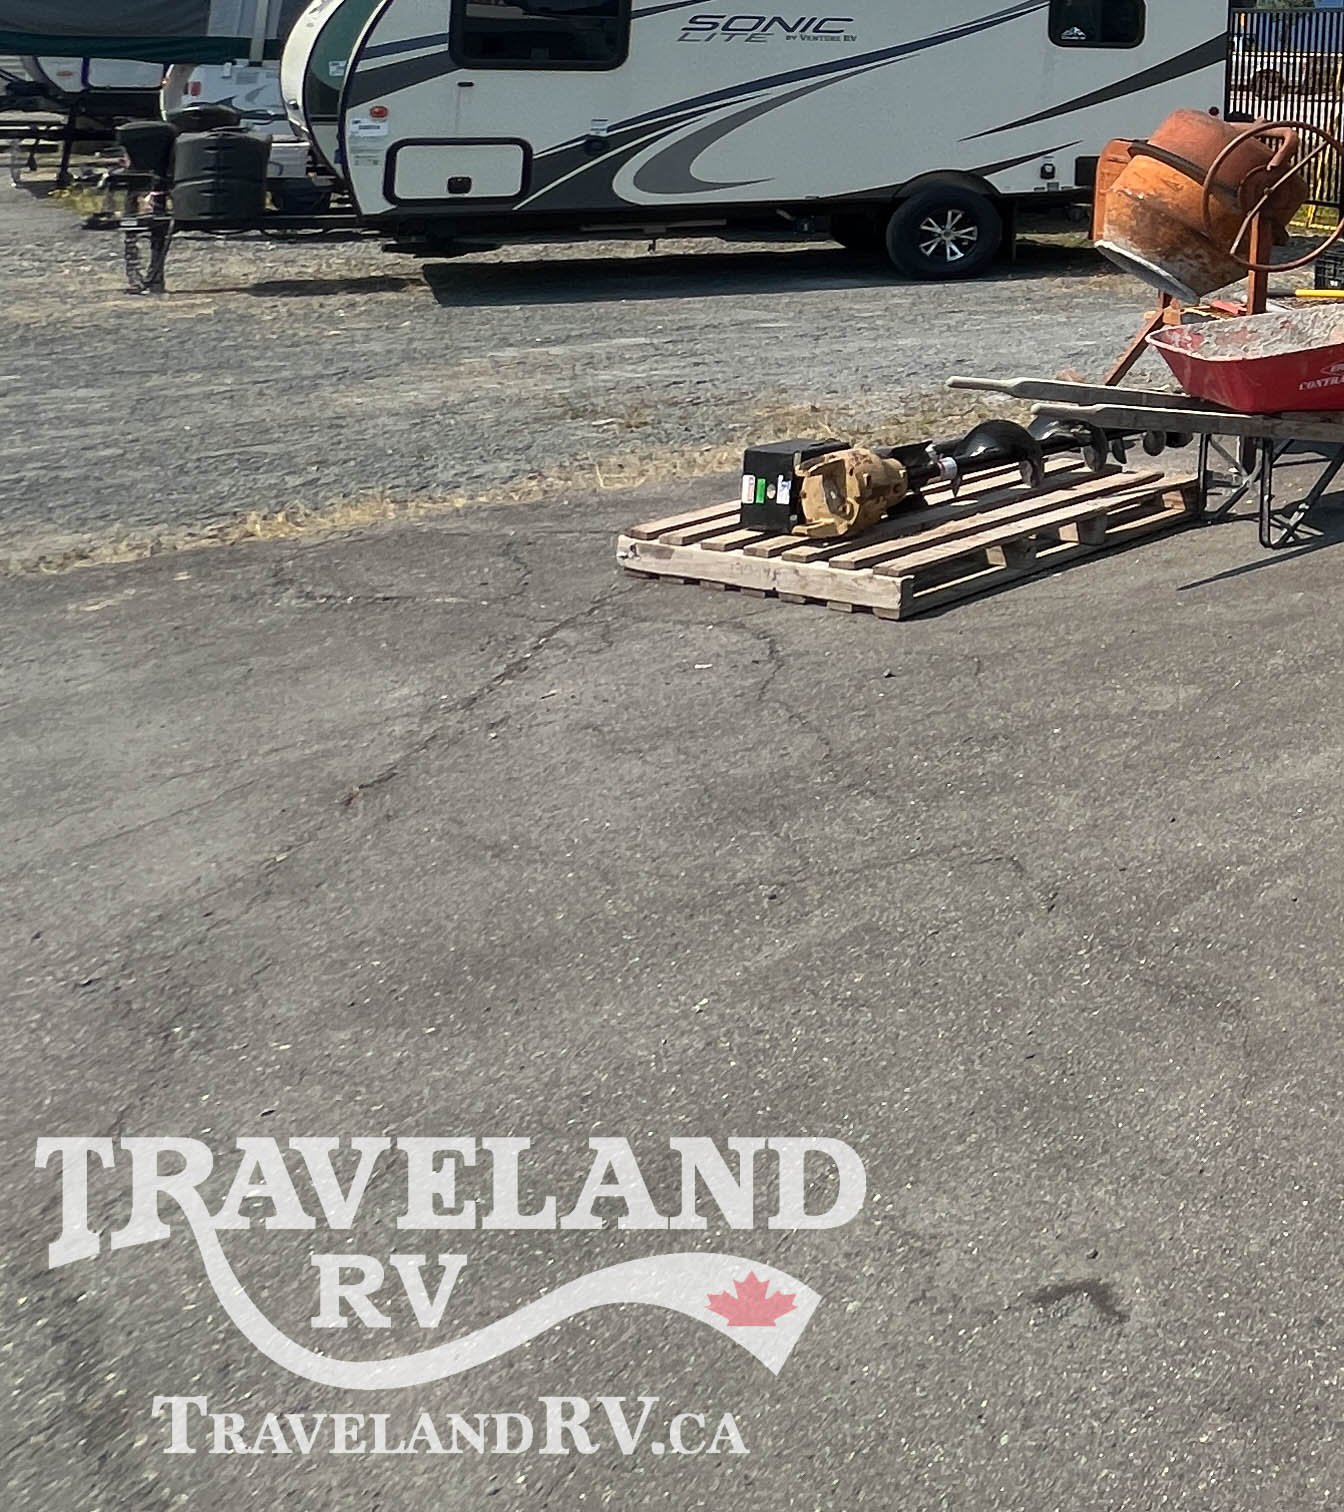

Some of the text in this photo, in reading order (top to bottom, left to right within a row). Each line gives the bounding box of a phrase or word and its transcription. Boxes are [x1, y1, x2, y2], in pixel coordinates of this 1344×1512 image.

[681, 14, 855, 34] SONIC
[677, 32, 775, 43] LITE
[843, 34, 857, 42] RV
